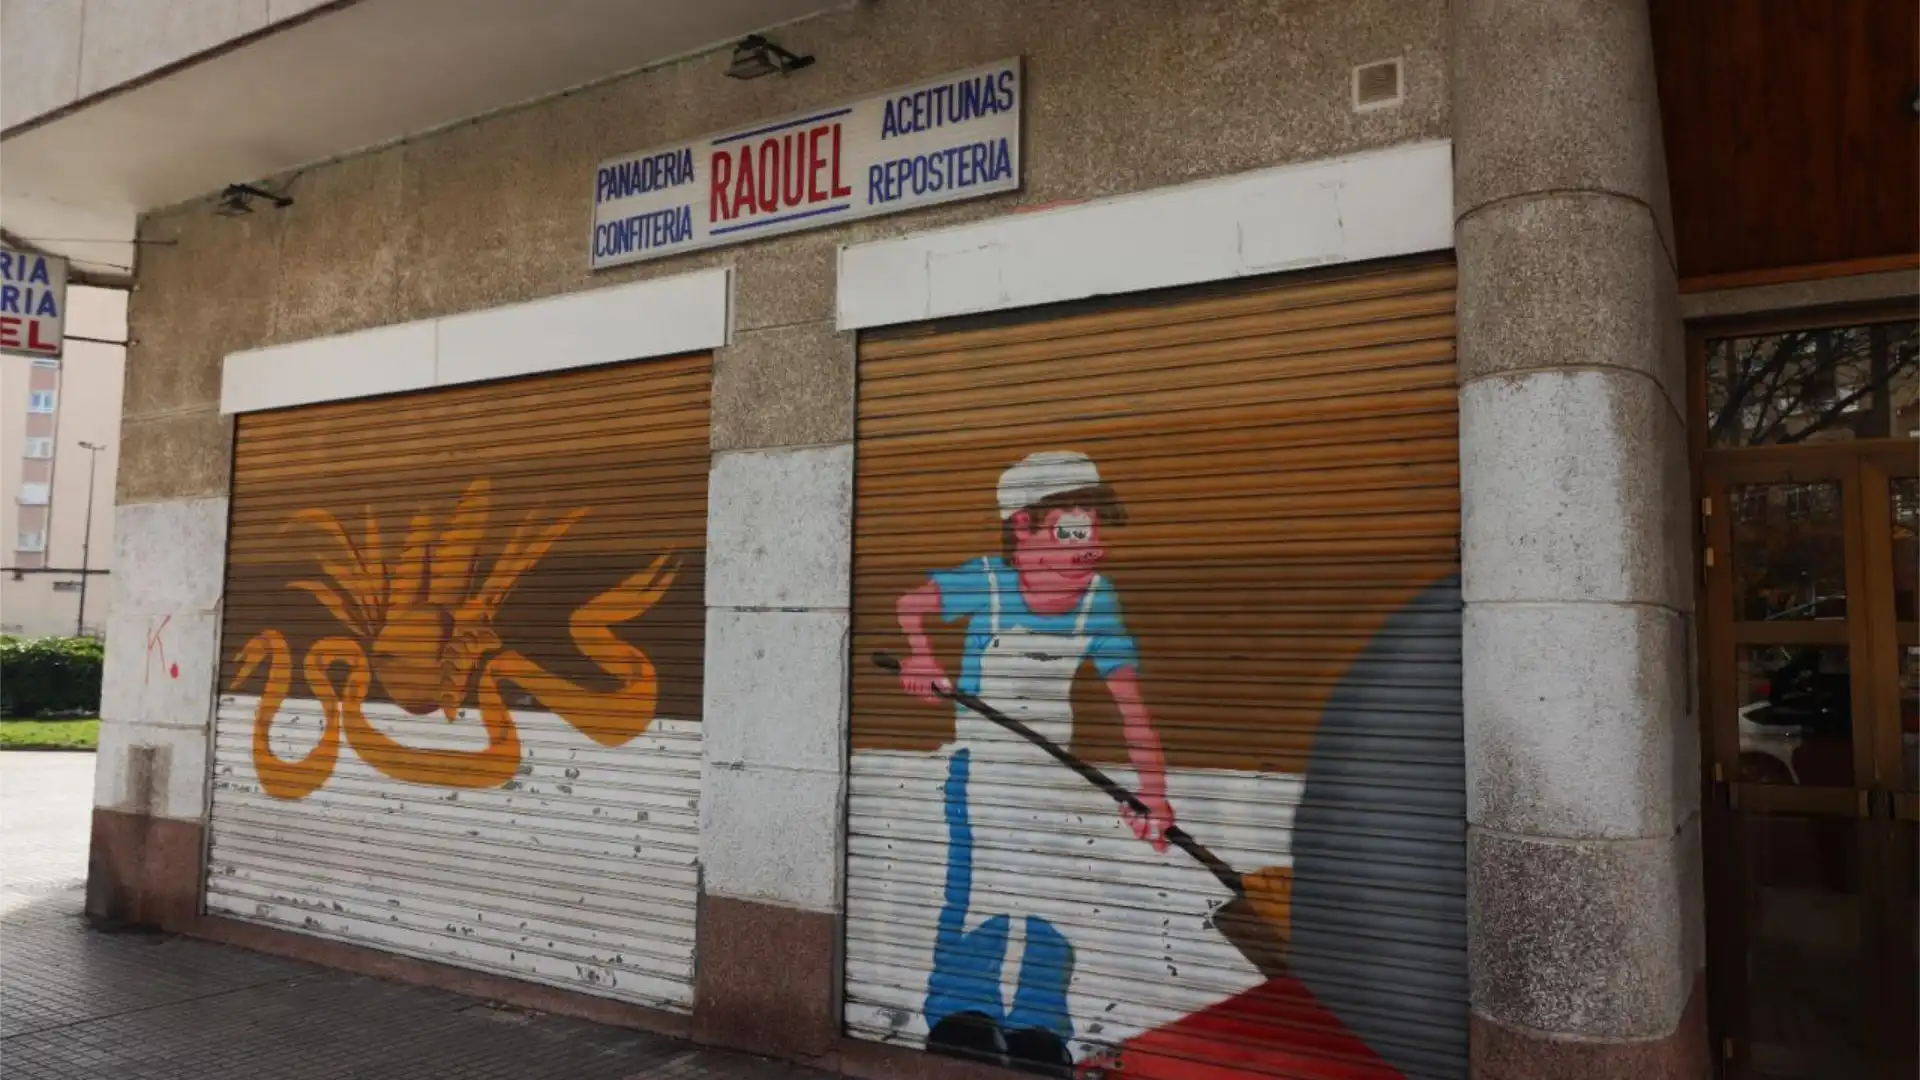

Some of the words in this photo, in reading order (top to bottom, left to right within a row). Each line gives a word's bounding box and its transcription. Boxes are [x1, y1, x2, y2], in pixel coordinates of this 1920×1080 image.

[881, 70, 1015, 140] ACEITUNAS
[597, 148, 694, 204] PANADERIA
[709, 123, 851, 223] RAQUEL
[868, 137, 1012, 205] REPOSTERIA
[595, 205, 693, 257] CONFITERIA
[0, 284, 57, 318] RIA
